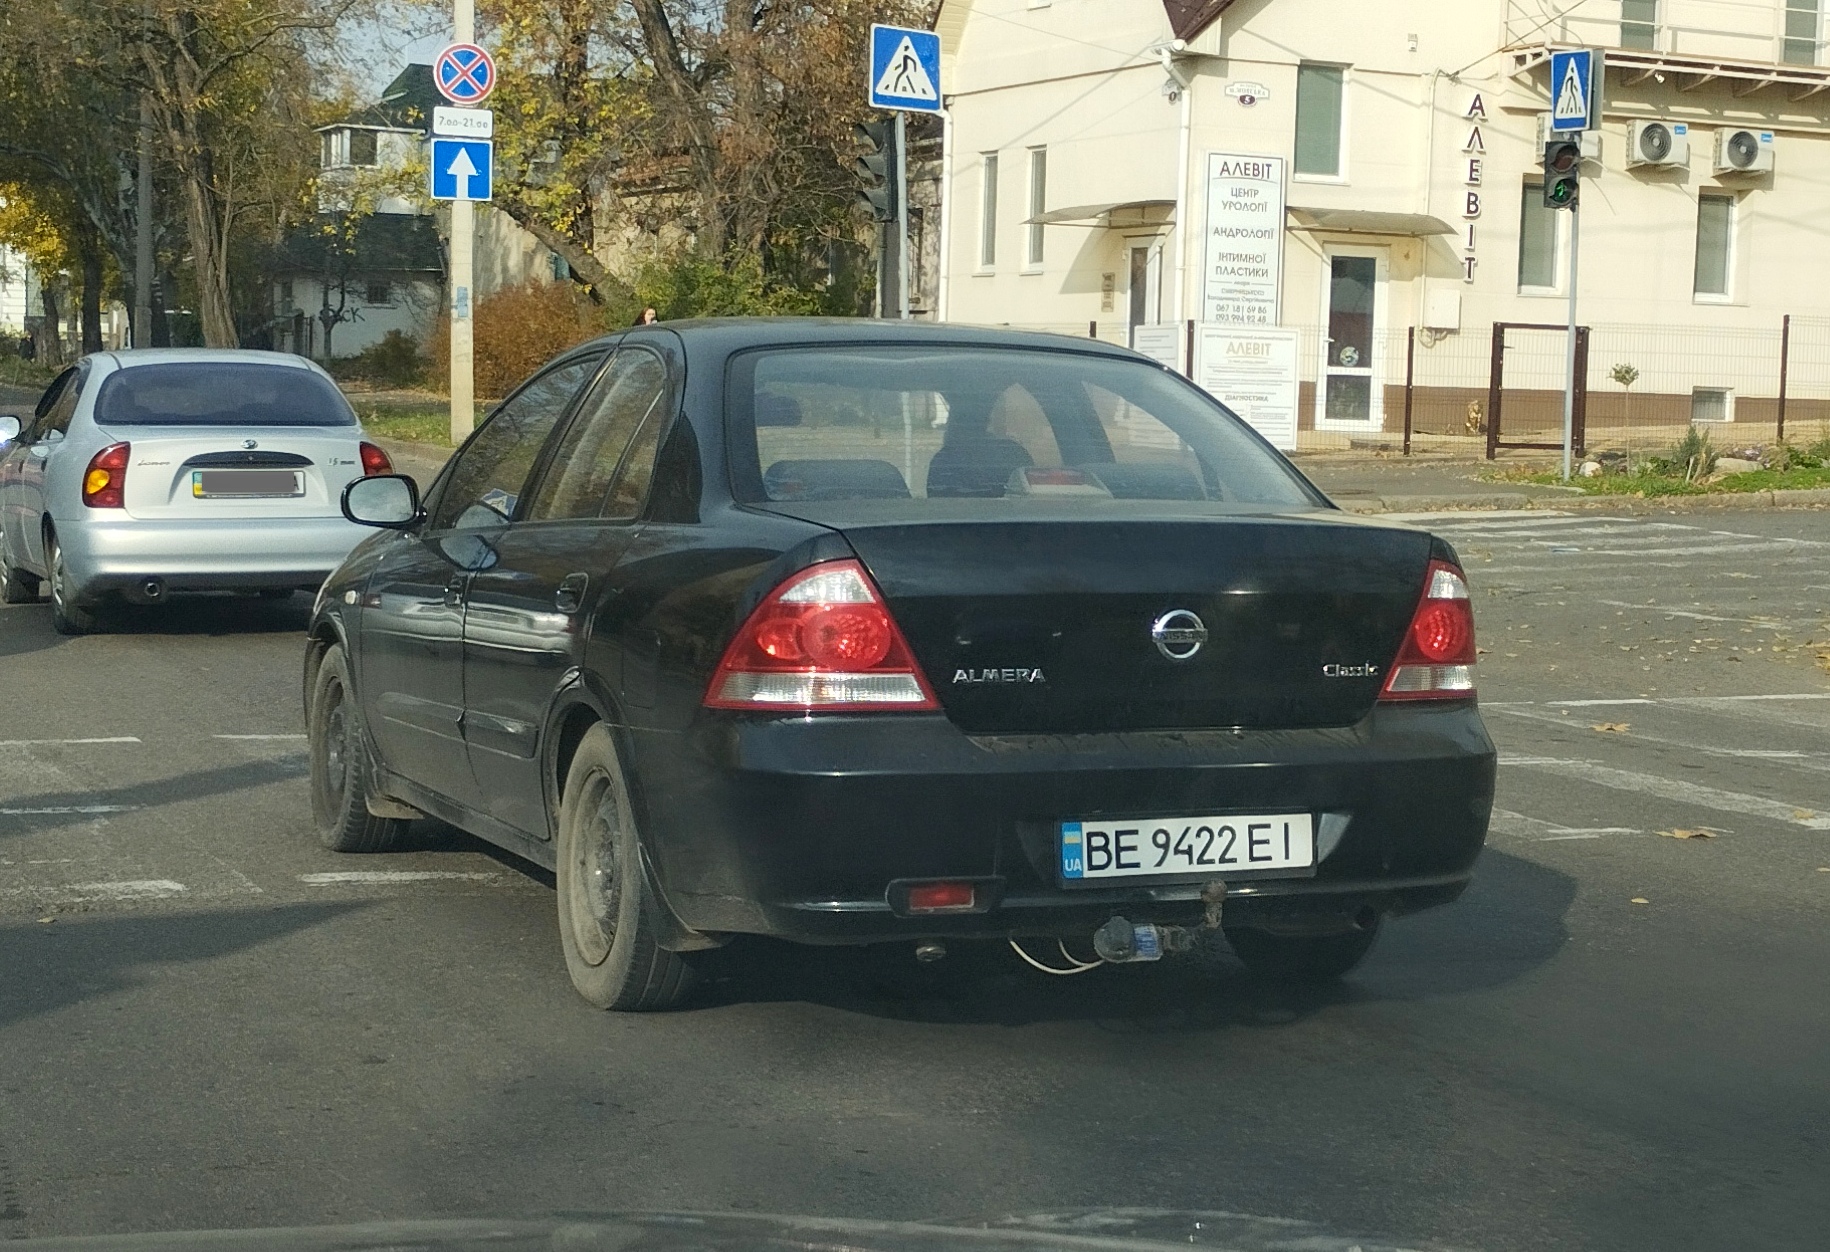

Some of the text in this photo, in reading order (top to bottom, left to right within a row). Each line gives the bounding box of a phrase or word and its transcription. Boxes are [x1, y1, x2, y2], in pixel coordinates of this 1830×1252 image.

[1220, 161, 1272, 179] АЛЕВІТ
[1231, 187, 1259, 198] ЦЕНТР
[1465, 93, 1486, 279] АЛЕВІТ
[1221, 200, 1268, 212] УРОЛОГІЇ
[1213, 227, 1275, 240] АНДРОЛОГІЇ
[1218, 251, 1267, 264] ІНТИМНОЇ
[1216, 265, 1269, 278] ПЛАСТИКИ
[1215, 304, 1229, 312] 067
[1258, 306, 1267, 314] 86
[1226, 341, 1271, 356] АЛЕВІТ
[1225, 394, 1270, 403] ДІАГНОСТИКА
[952, 668, 1046, 683] ALMERA
[1322, 663, 1379, 677] Classic
[1065, 822, 1290, 871] UA BE 9422 EI
